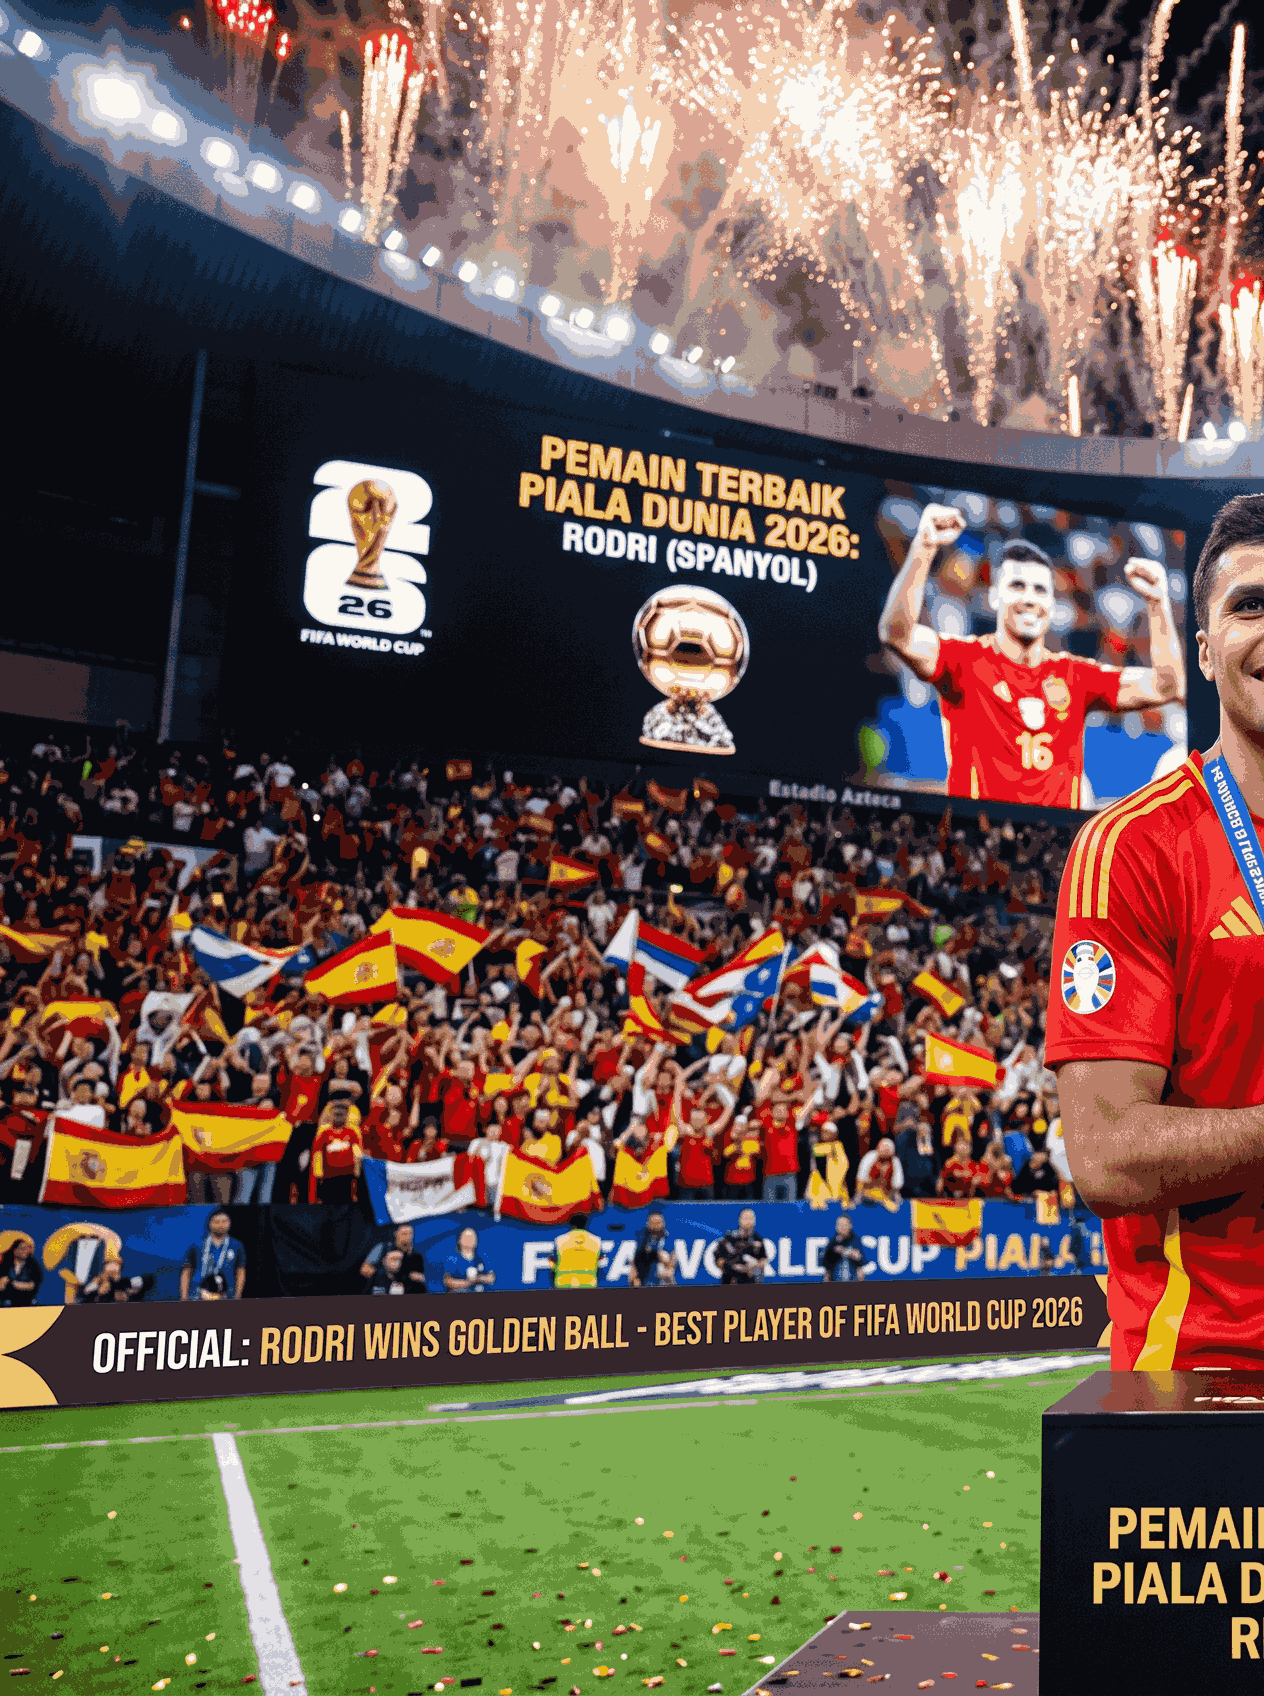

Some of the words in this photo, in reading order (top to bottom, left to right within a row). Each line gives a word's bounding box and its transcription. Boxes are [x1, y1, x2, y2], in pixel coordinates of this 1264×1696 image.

[540, 434, 687, 493] PEMAIN
[695, 461, 847, 520] TERBAIK
[519, 472, 632, 524] PIALA
[642, 492, 756, 543] DUNIA
[764, 514, 860, 560] 2026:
[562, 521, 657, 564] RODRI
[666, 538, 818, 593] (SPANYOL)
[338, 595, 393, 619] 26
[300, 628, 335, 646] FIFA
[336, 632, 392, 652] WORLD
[393, 640, 425, 656] CUP
[1015, 731, 1053, 771] 16
[521, 1239, 638, 1284] FA
[92, 1328, 250, 1374] OFFICIAL:
[260, 1323, 355, 1365] RODRI
[364, 1320, 440, 1360] WINS
[448, 1316, 556, 1357] GOLDEN
[564, 1313, 630, 1351] BALL
[654, 1310, 718, 1347] BEST
[723, 1306, 812, 1343] PLAYER
[819, 1305, 848, 1338] OF
[853, 1303, 900, 1337] FIFA
[906, 1300, 980, 1334] WORLD
[986, 1298, 1026, 1330] CUP
[1032, 1296, 1083, 1328] 2026
[1092, 1561, 1228, 1605] PIALA
